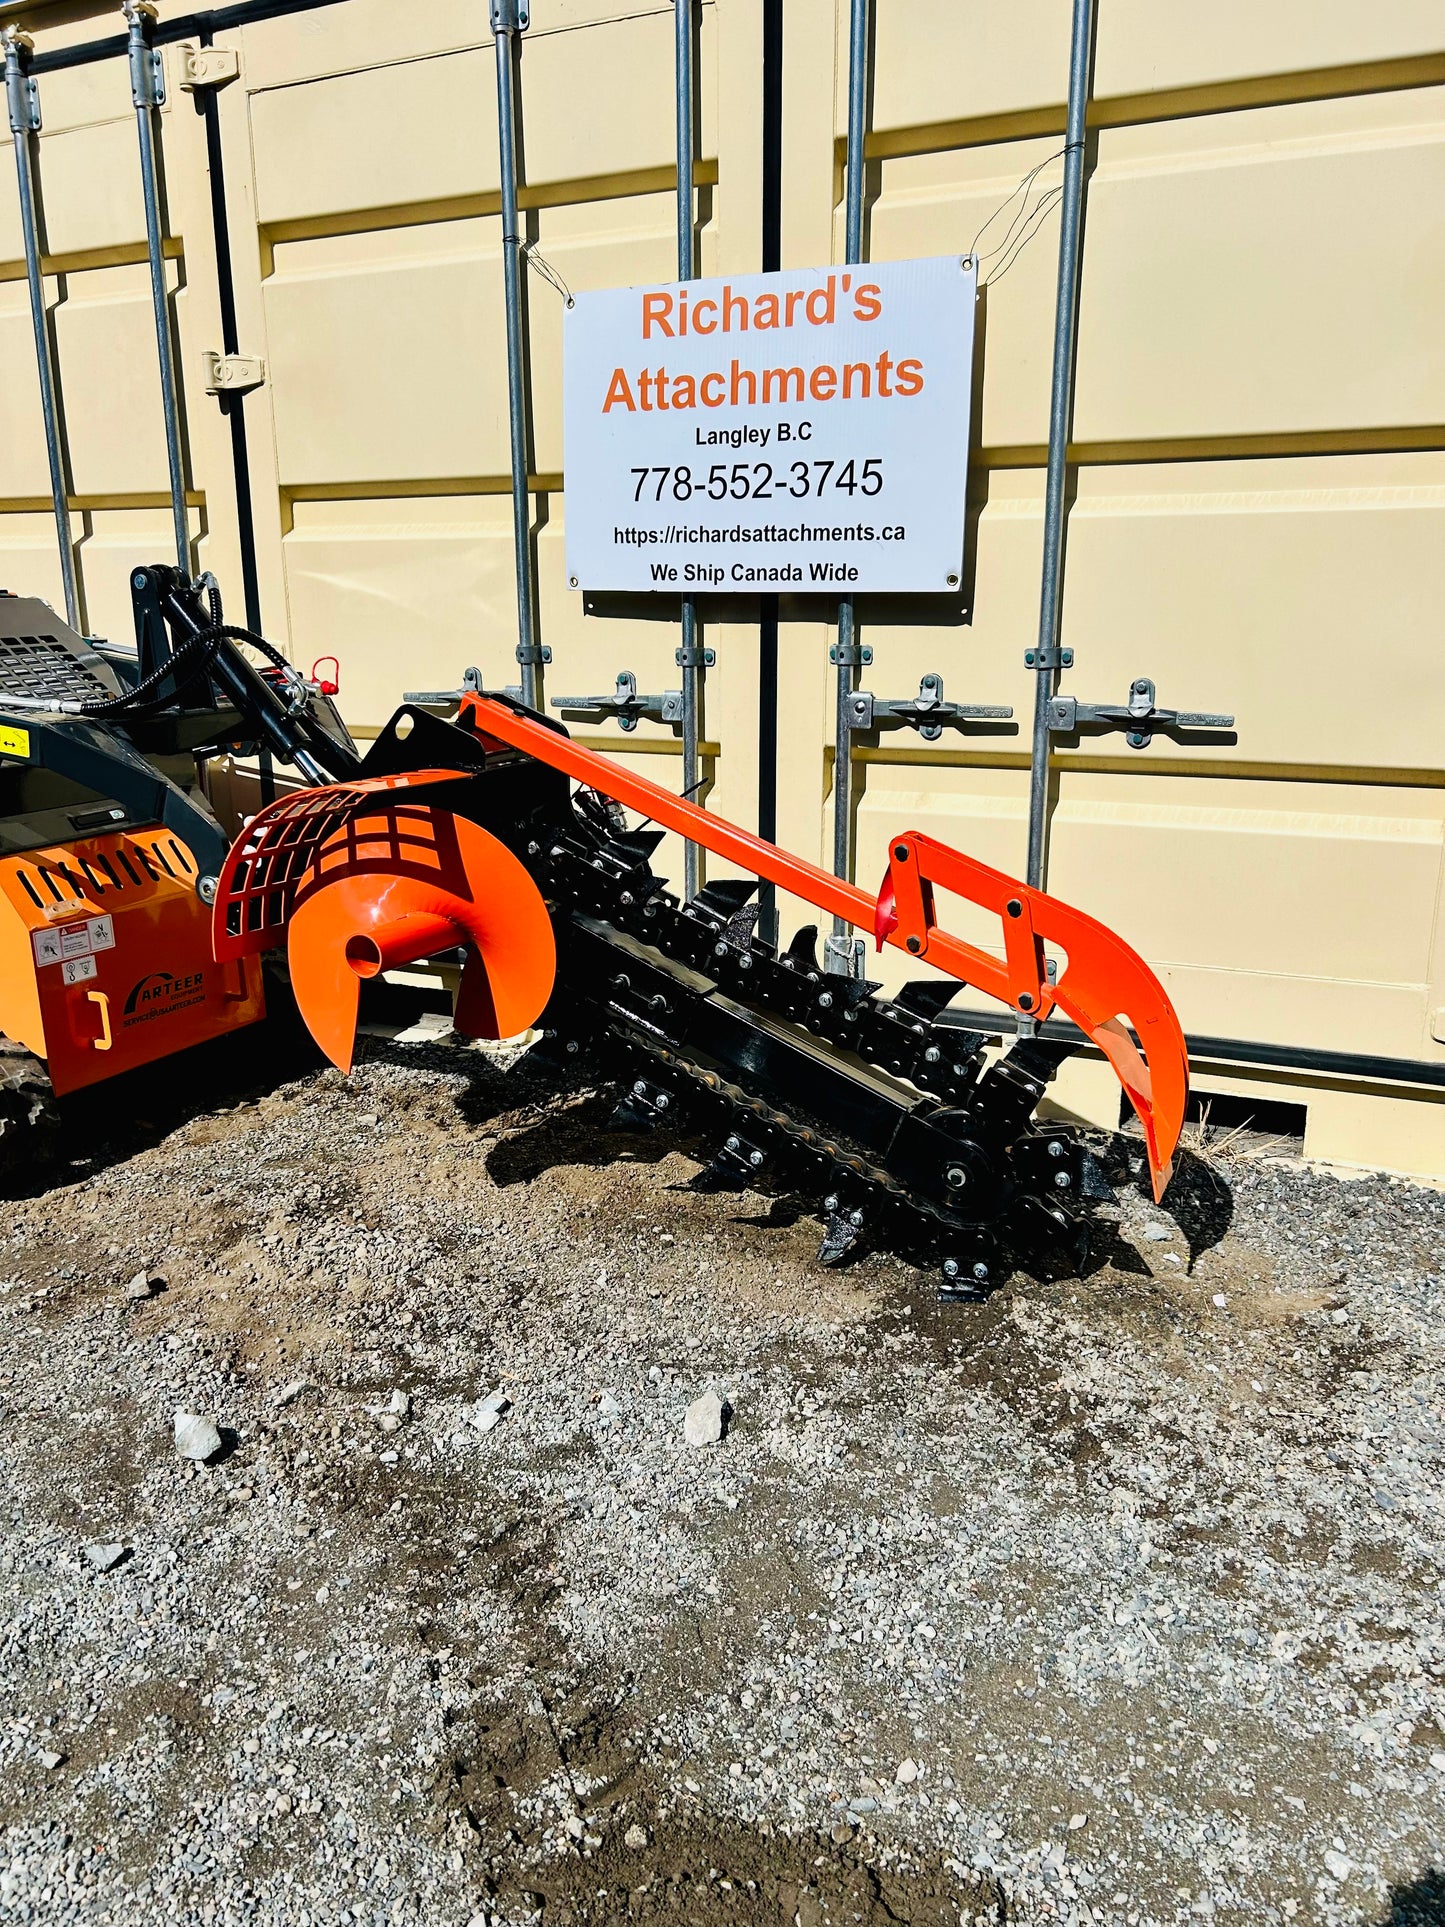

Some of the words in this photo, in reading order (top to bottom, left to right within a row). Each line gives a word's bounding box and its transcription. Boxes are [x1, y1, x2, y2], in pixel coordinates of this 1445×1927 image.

[642, 273, 882, 339] Richard's
[602, 350, 924, 413] Attachments
[696, 425, 771, 448] Langley
[778, 421, 812, 442] B.C
[631, 458, 883, 502] 778-552-3745
[614, 523, 905, 547] https://richardsattachments.ca
[651, 564, 678, 582] We
[684, 564, 725, 585] Ship
[731, 563, 803, 582] Canada
[809, 562, 859, 582] Wide
[141, 972, 203, 1002] ARTEER
